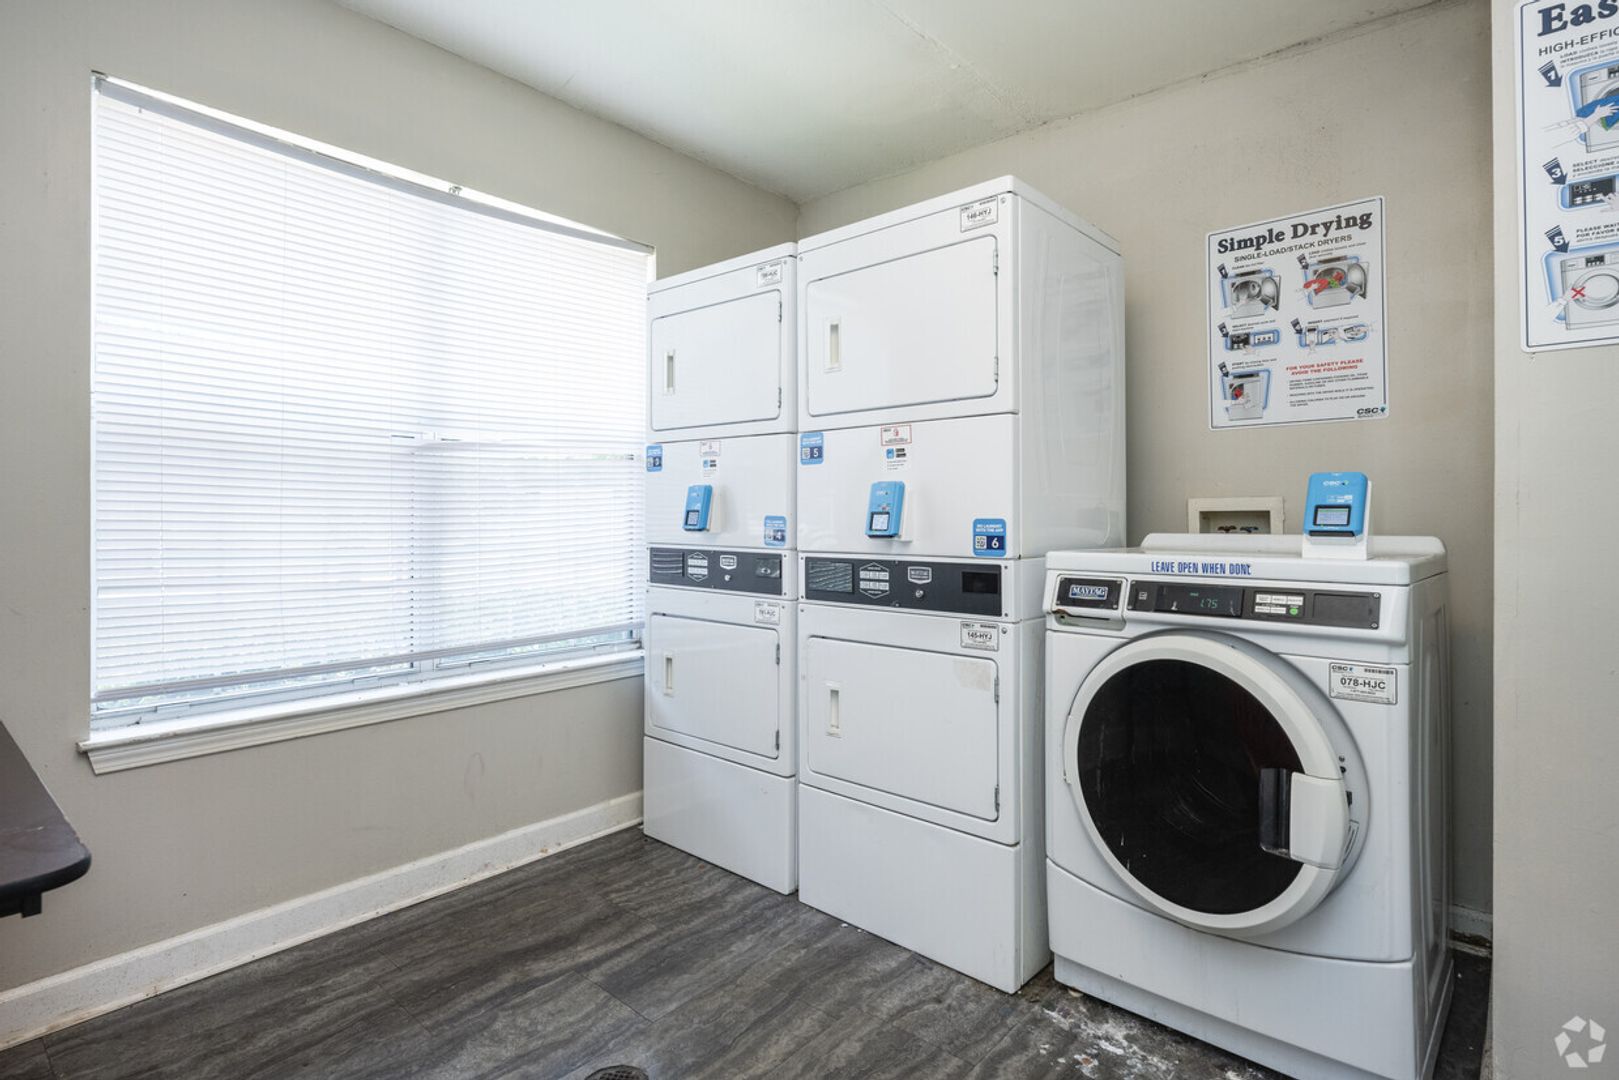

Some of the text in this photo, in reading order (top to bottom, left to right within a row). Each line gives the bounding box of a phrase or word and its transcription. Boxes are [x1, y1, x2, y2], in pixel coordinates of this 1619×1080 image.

[1547, 70, 1556, 80] 1
[1572, 159, 1597, 168] SELECT
[1551, 168, 1562, 178] 3
[1217, 212, 1373, 255] Simple Drying
[1576, 224, 1602, 233] PLEASE
[1553, 236, 1564, 246] 5
[1234, 241, 1316, 263] SINGLE-LOAD/STACK
[1317, 234, 1353, 247] DRYERS
[1322, 364, 1359, 373] FOLLOWING
[1356, 407, 1379, 415] CSC
[813, 447, 820, 457] 5
[991, 537, 999, 549] 6
[1151, 561, 1175, 573] LEAVE
[1177, 562, 1199, 574] OPEN
[1201, 562, 1226, 575] WHEN
[1071, 586, 1105, 597] MAYTAG
[1340, 677, 1386, 690] 078-HJC
